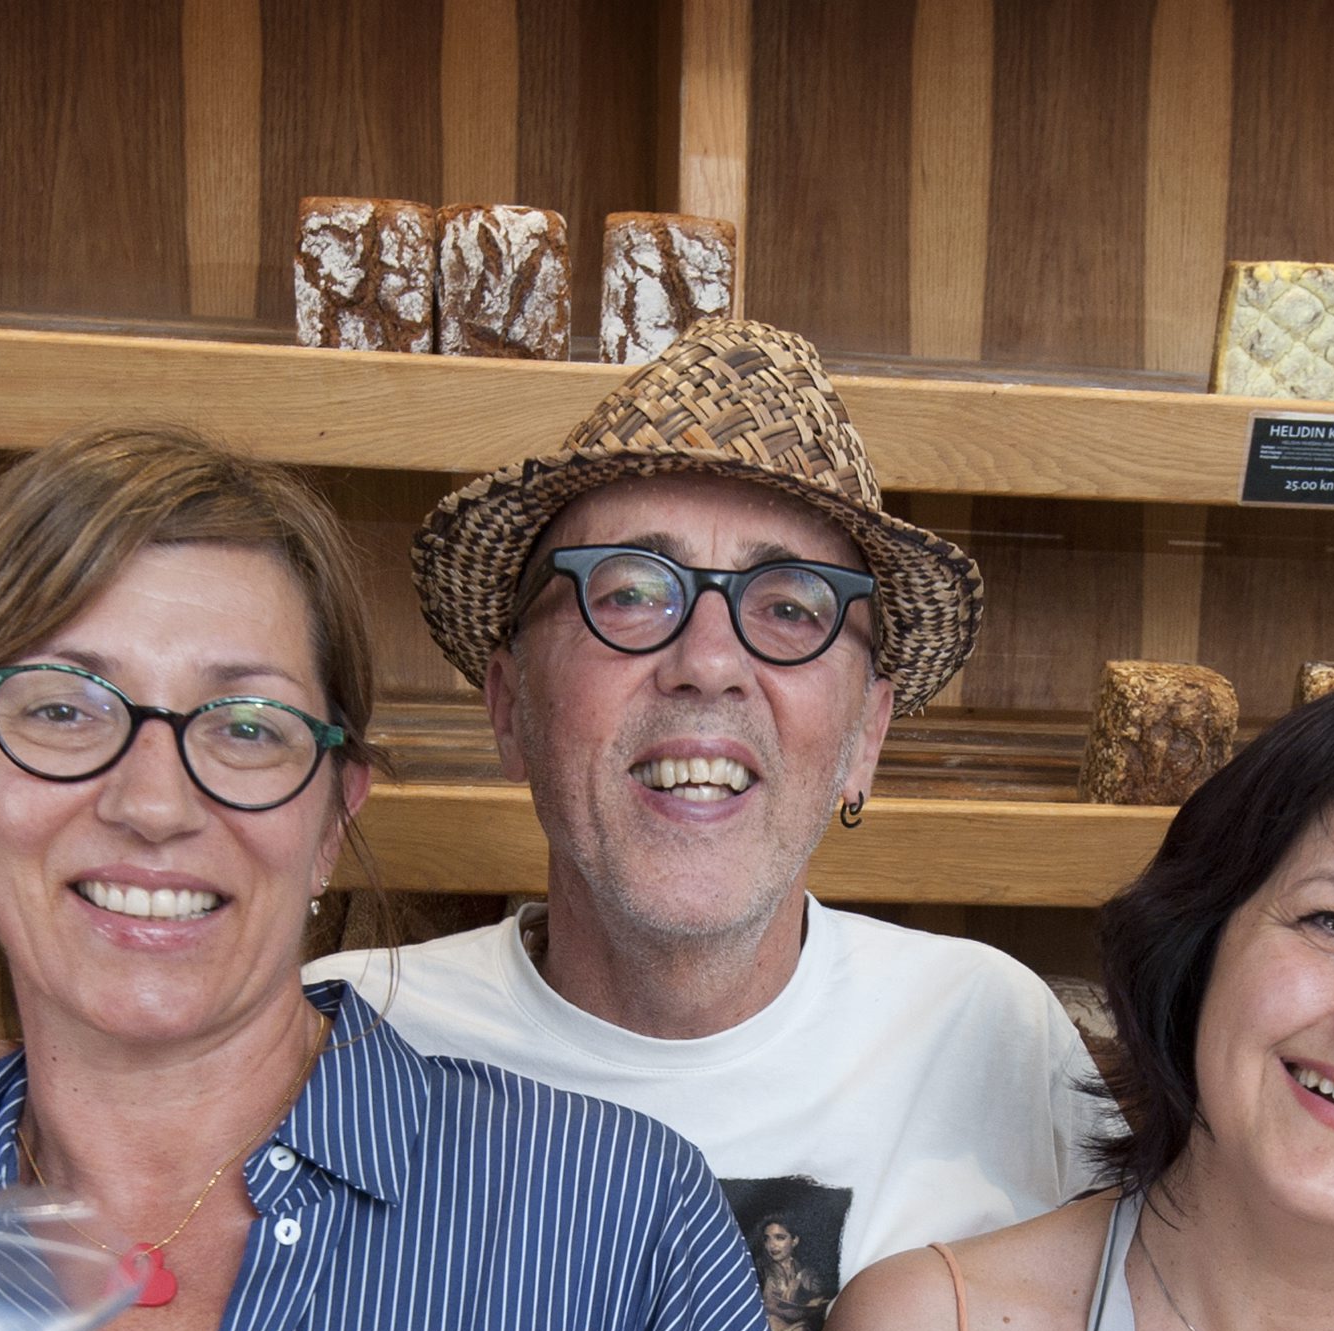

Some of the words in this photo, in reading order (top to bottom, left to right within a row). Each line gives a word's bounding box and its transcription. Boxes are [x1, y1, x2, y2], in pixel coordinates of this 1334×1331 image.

[1269, 425, 1325, 438] HELJDIN
[1284, 480, 1318, 492] 25.00
[1319, 479, 1334, 491] kn
